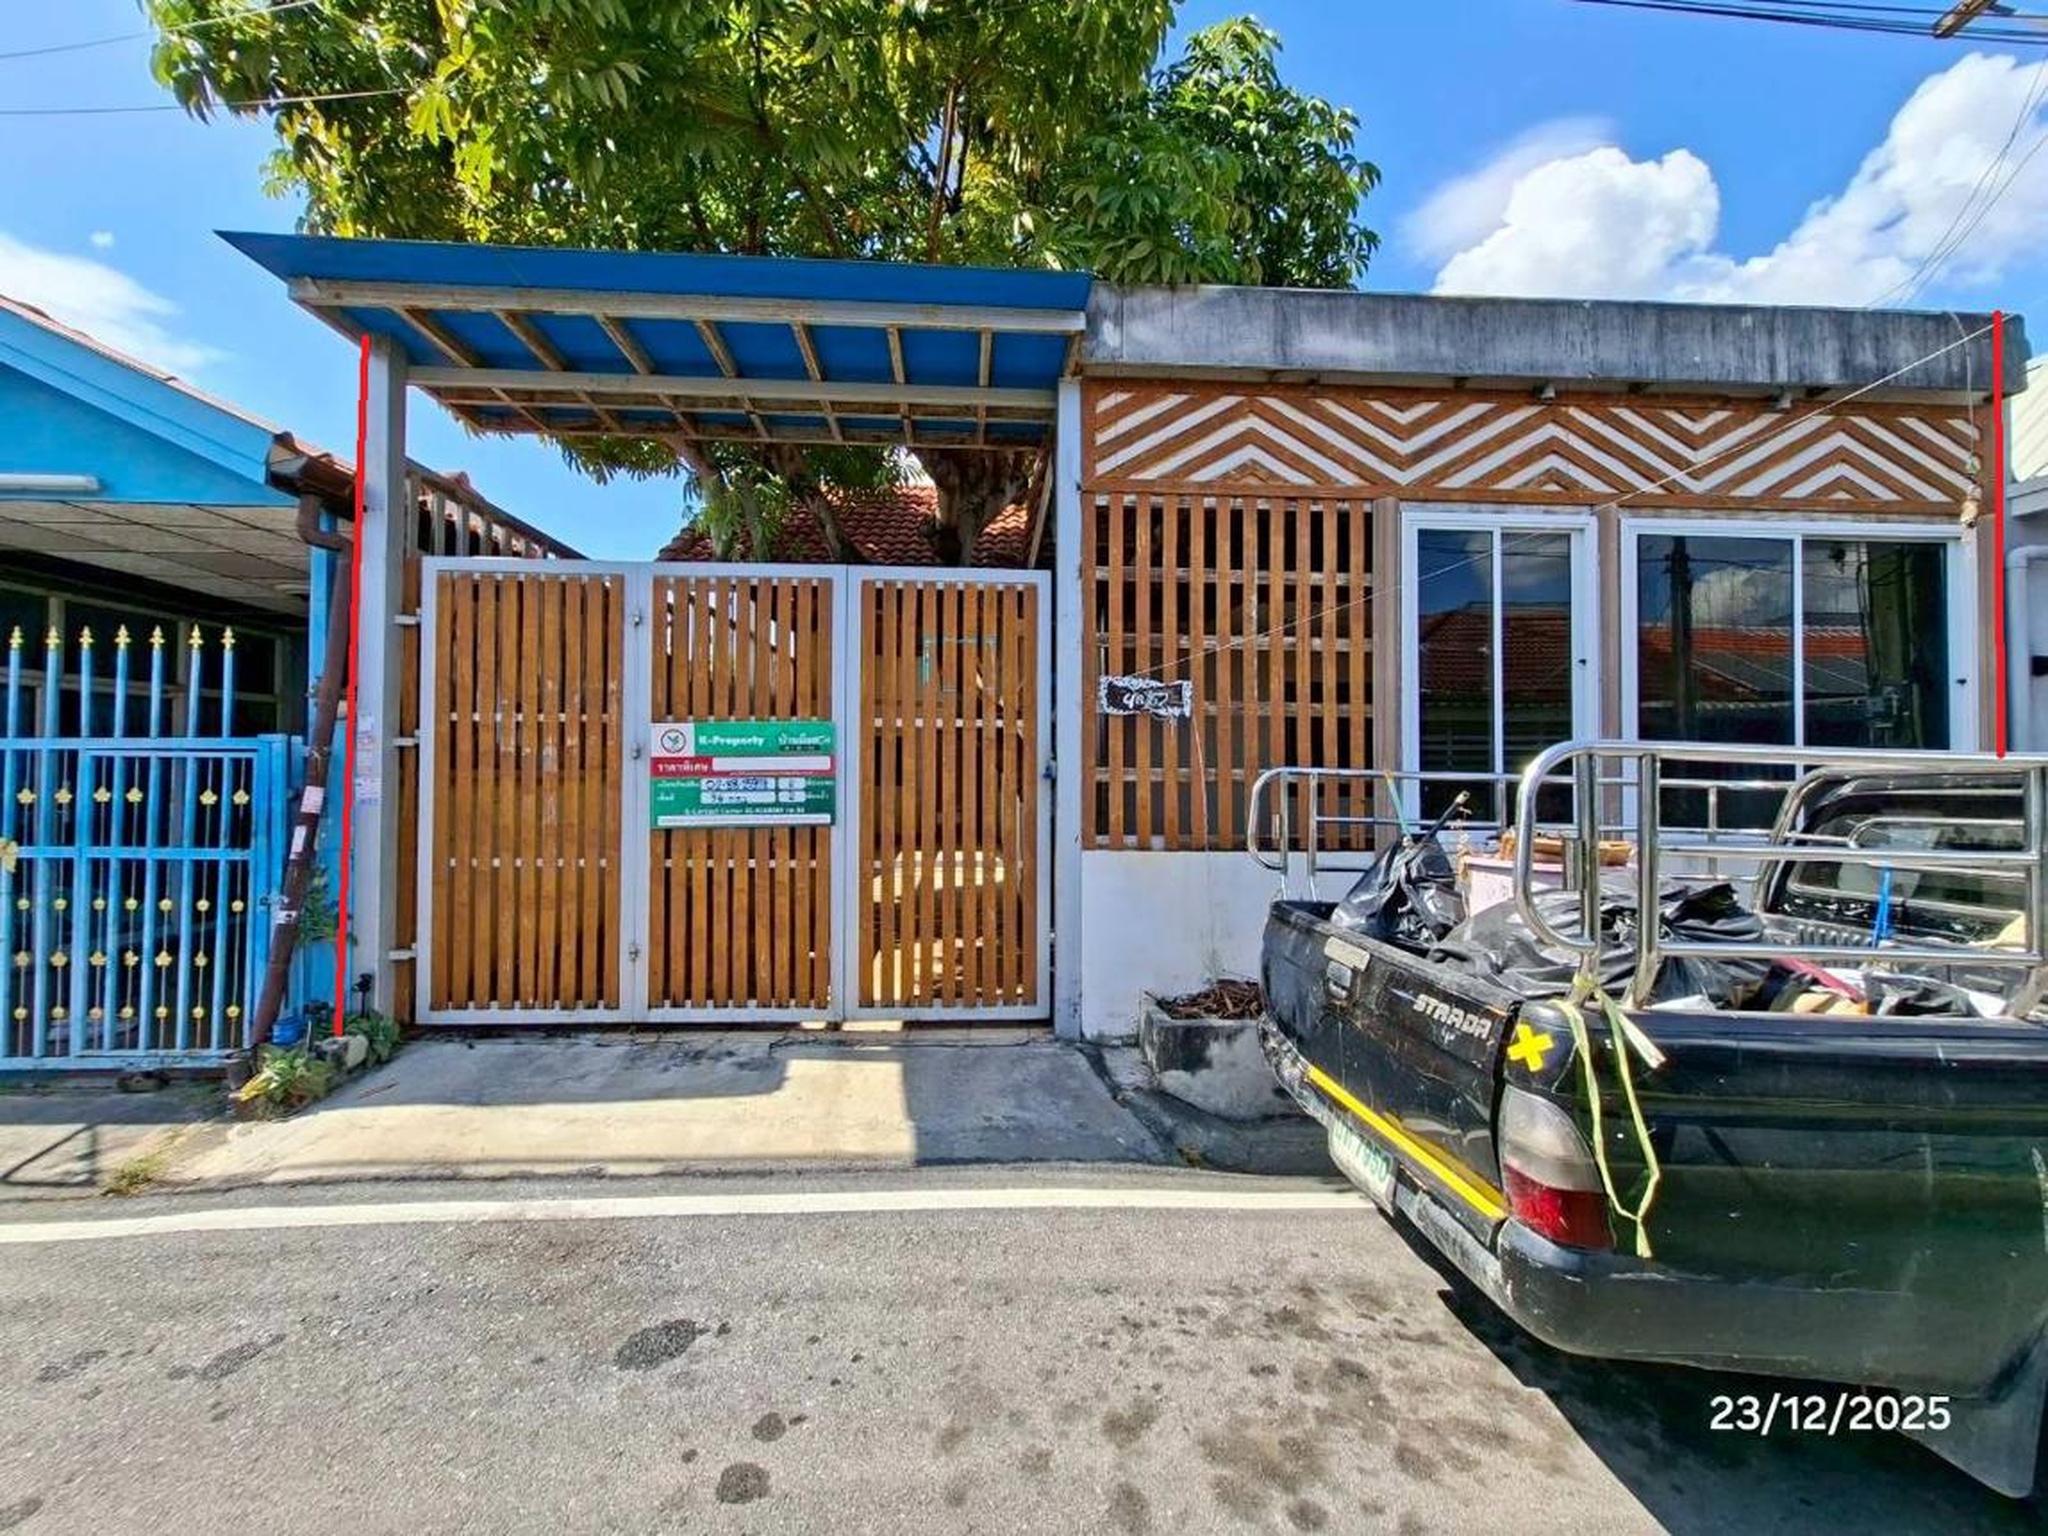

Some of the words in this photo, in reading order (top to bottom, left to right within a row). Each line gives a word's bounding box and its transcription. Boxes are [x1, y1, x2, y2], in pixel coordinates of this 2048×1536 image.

[657, 760, 709, 772] ราคาพิเศษ
[1413, 994, 1492, 1040] STRADA
